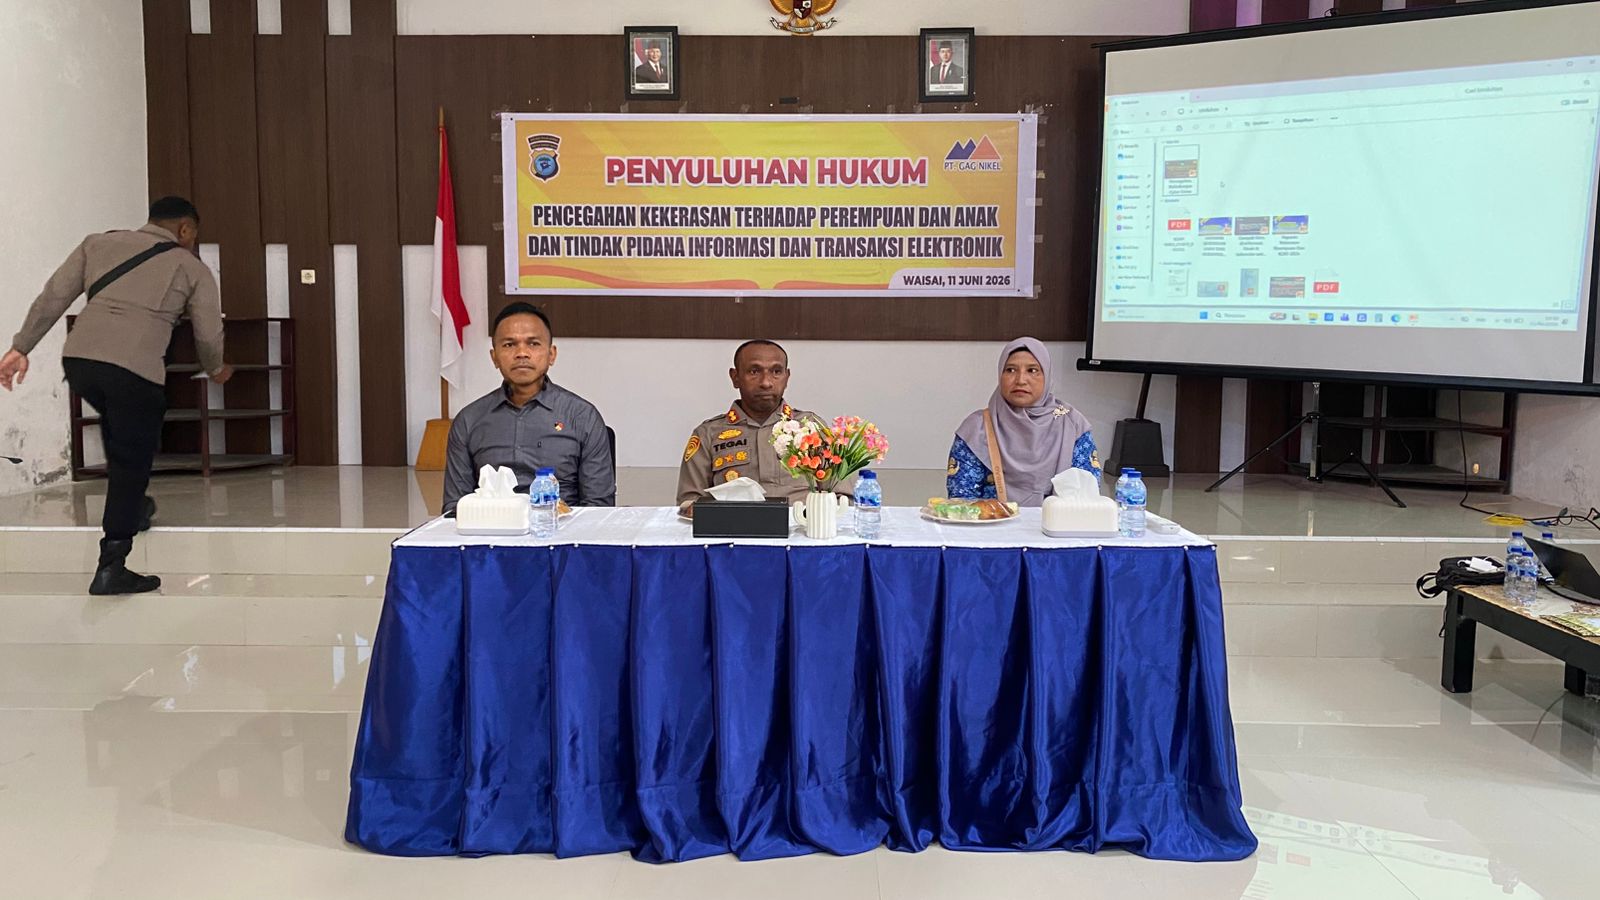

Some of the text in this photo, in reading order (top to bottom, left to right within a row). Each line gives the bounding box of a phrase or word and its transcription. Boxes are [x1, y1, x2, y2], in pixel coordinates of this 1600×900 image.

[606, 158, 927, 185] PENYULUHAN HUKUM
[958, 162, 977, 170] GAG
[978, 162, 1001, 170] NIKEL
[533, 205, 998, 228] PENCEGAHAN KEKERASAN TERHADAP PEREMPUAN DAN ANAK
[528, 236, 1003, 258] DAN TINDAK PIDANA INFORMASI DAN TRANSAKSI ELEKTRONIK
[903, 275, 1011, 287] WAISAI, 11 JUNI 2026
[1316, 283, 1335, 291] PDF
[713, 439, 747, 452] TEGAI
